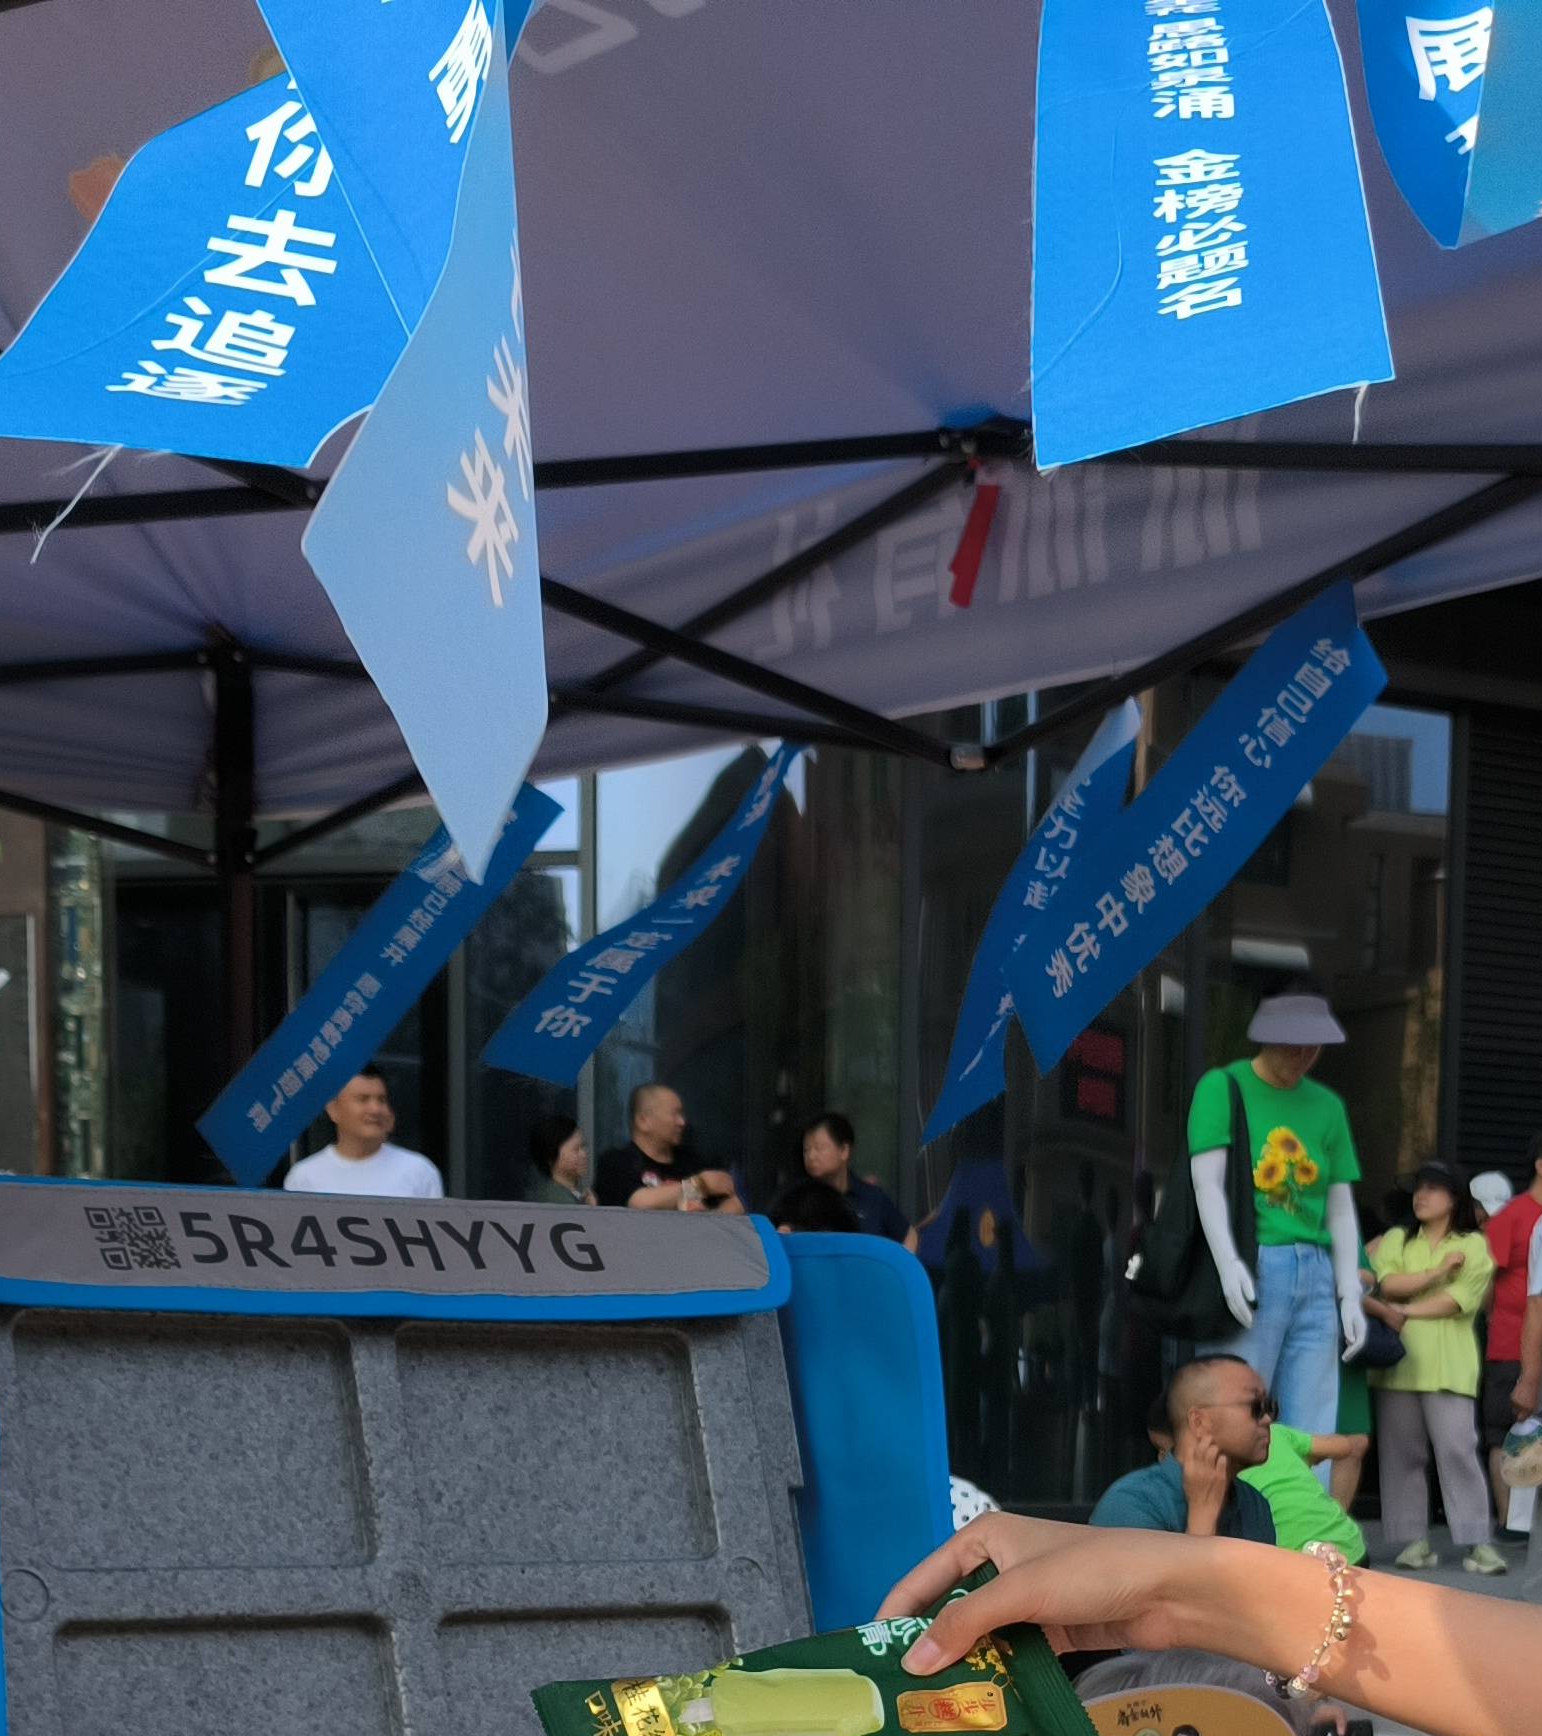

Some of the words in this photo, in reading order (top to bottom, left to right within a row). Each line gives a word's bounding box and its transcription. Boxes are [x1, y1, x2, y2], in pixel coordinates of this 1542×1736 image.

[105, 99, 338, 406] 你去追逐
[1152, 149, 1249, 320] 金榜必题名
[1242, 637, 1353, 770] 给自己信心
[533, 852, 743, 1041] 未来一定属于你
[1043, 763, 1249, 1001] 你远比想象中优秀
[179, 1210, 607, 1275] 5R4SHYYG
